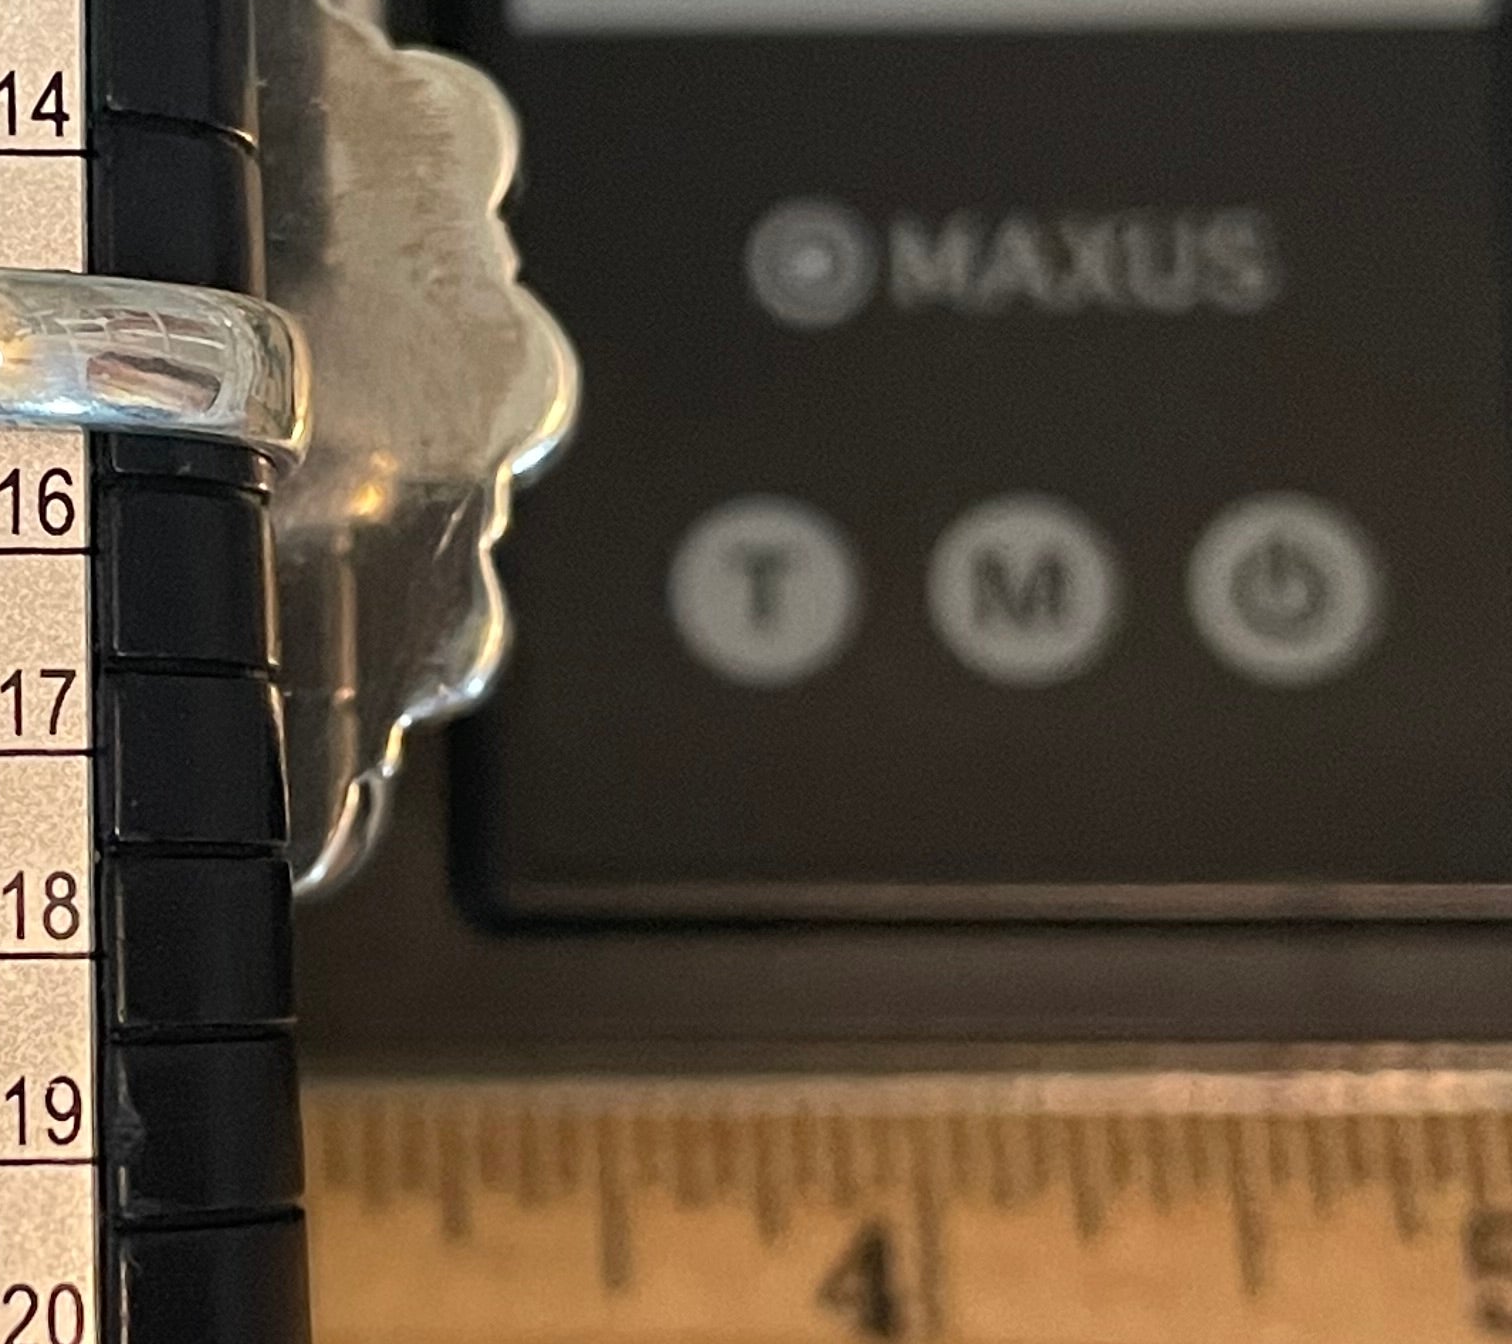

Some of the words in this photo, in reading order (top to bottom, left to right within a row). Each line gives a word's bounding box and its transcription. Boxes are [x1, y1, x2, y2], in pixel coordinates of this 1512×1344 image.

[890, 206, 1284, 316] MAXUS
[724, 544, 800, 634] T
[970, 548, 1070, 630] M
[0, 668, 77, 737] 17
[1, 869, 79, 941] 18
[4, 1074, 82, 1146] 19
[816, 1218, 904, 1344] 4
